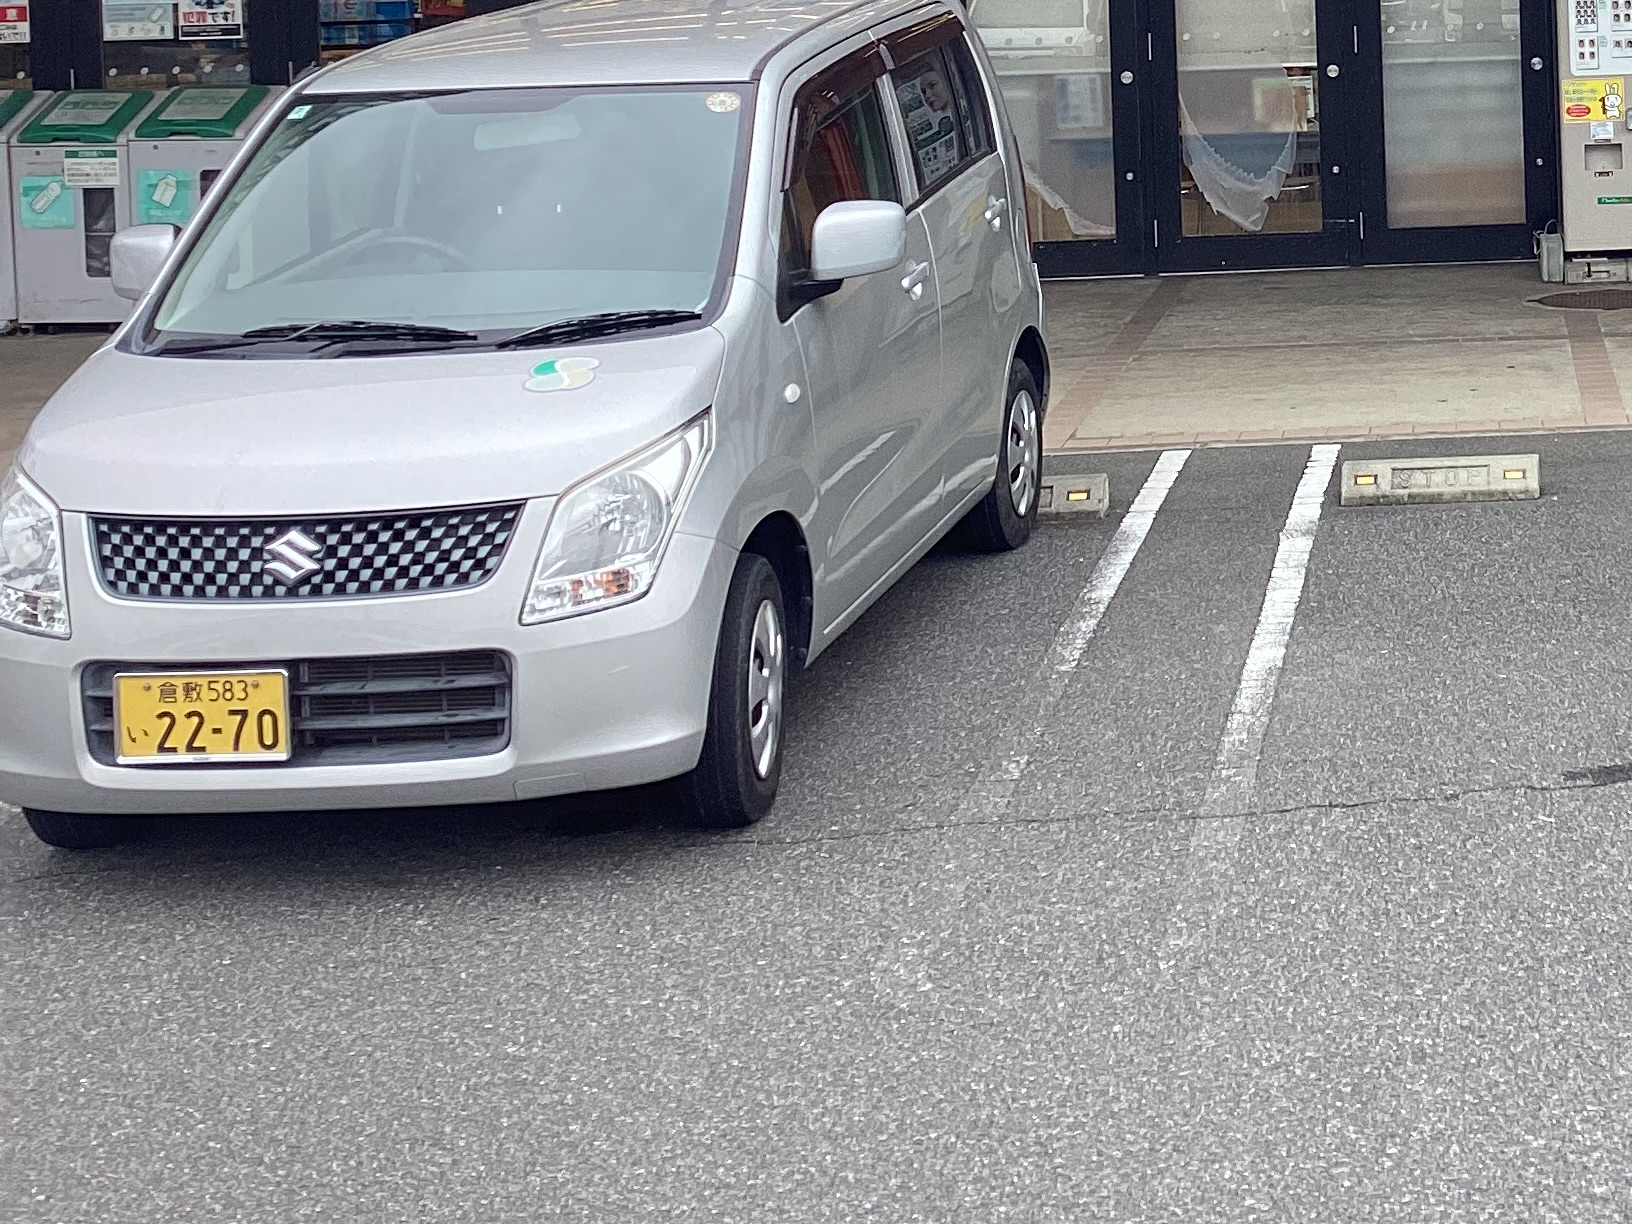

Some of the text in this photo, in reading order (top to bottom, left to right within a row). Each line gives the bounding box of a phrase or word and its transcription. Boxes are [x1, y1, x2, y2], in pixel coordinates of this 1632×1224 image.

[1399, 469, 1481, 489] STOP
[157, 680, 249, 704] 倉敷583
[127, 708, 280, 754] い 22-70
